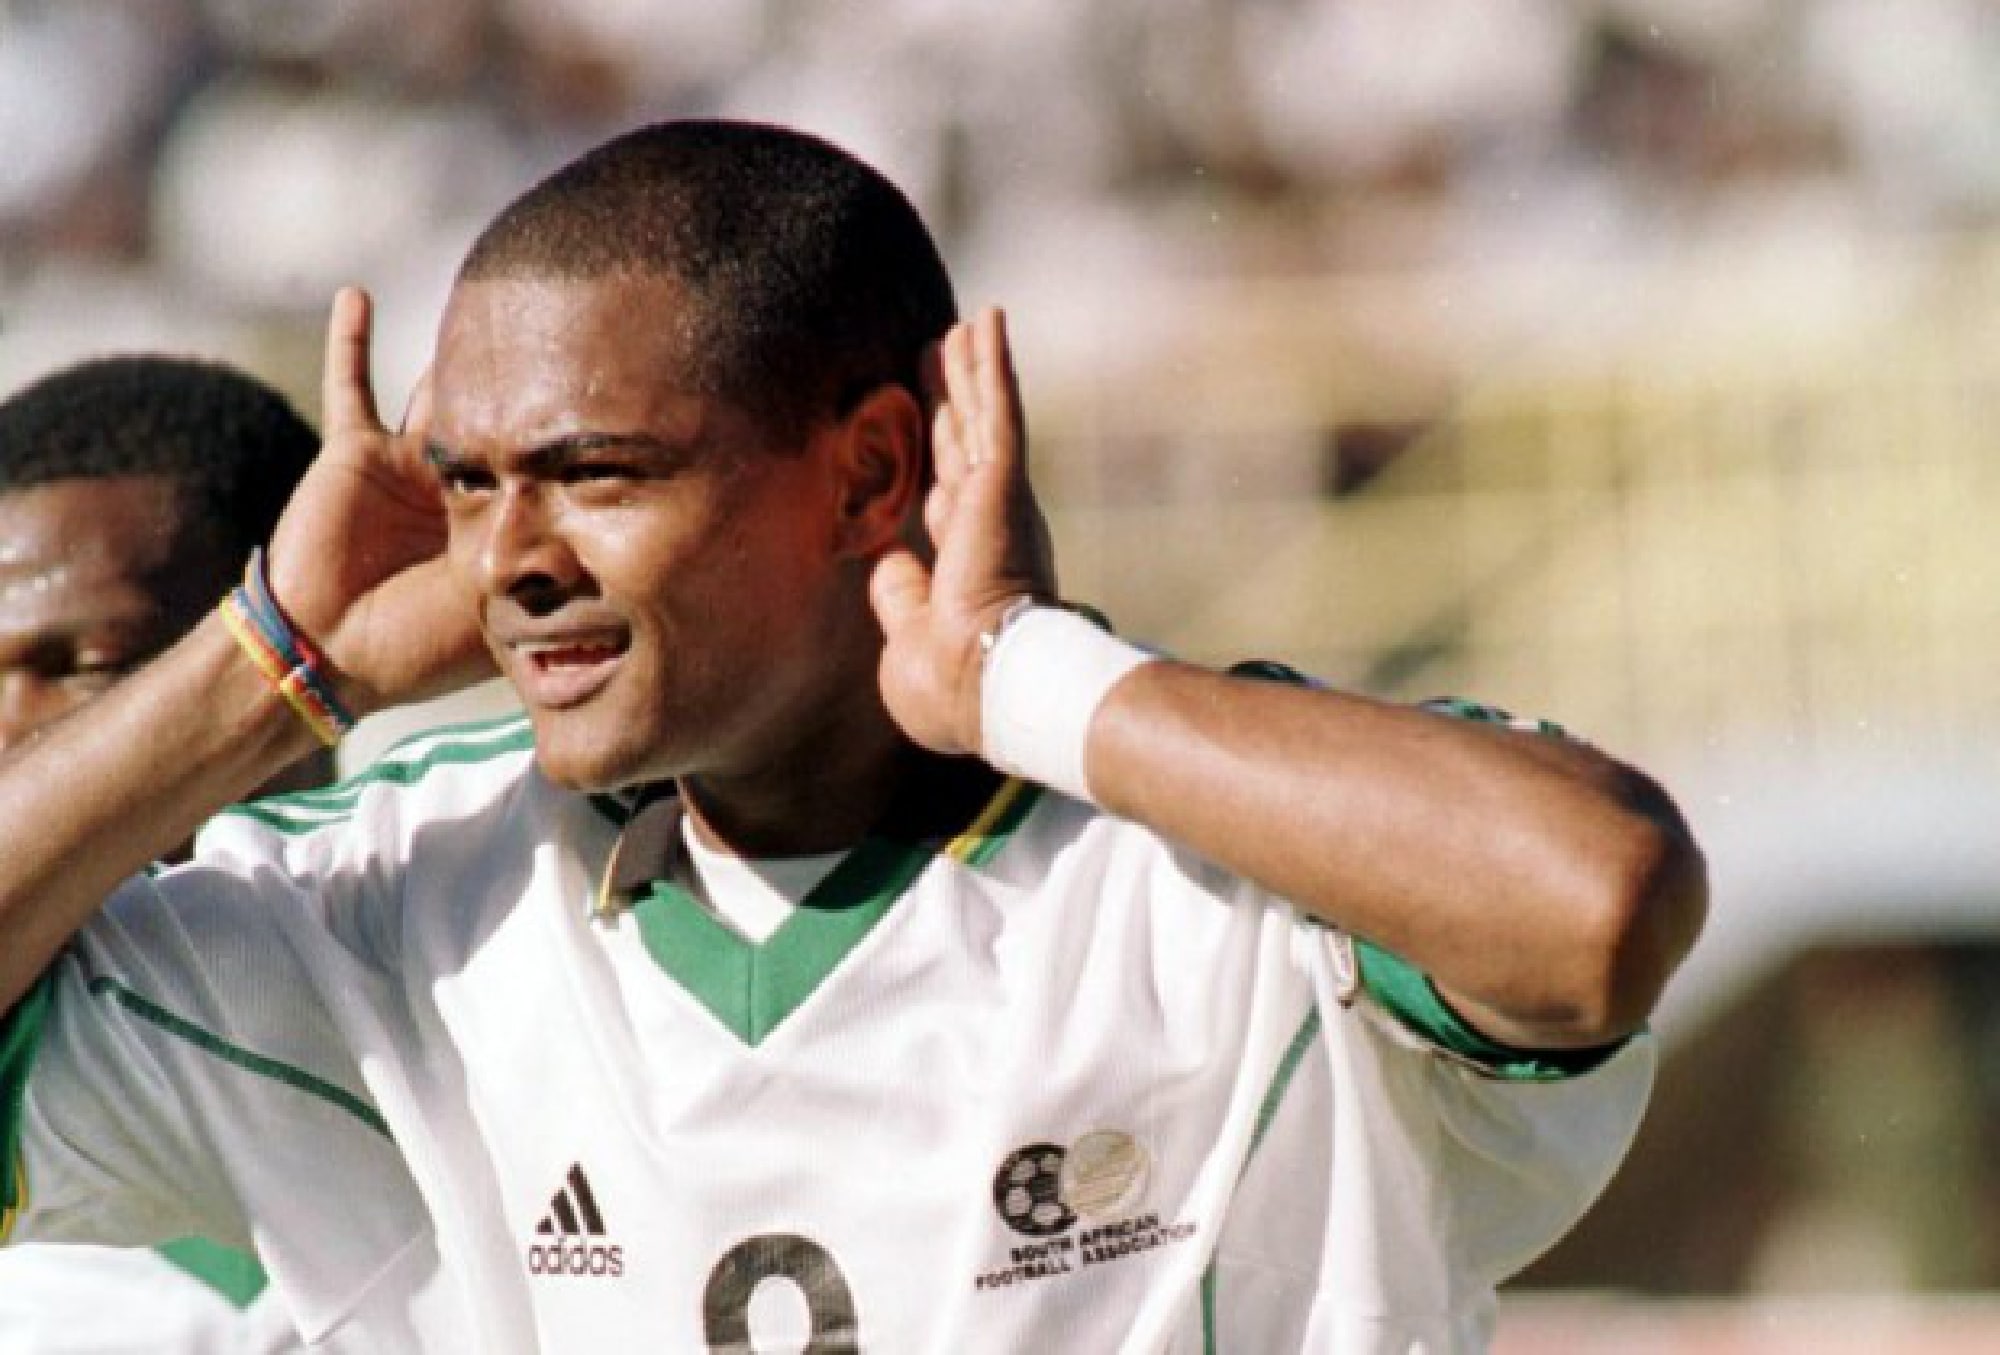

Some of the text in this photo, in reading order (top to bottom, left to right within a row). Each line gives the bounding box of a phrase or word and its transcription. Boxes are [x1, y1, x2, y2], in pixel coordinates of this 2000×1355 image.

[528, 1236, 623, 1277] adidas
[974, 1222, 1197, 1290] FOOTBALL ASSOCIATION
[1009, 1212, 1159, 1263] SOUTH AFRICAN
